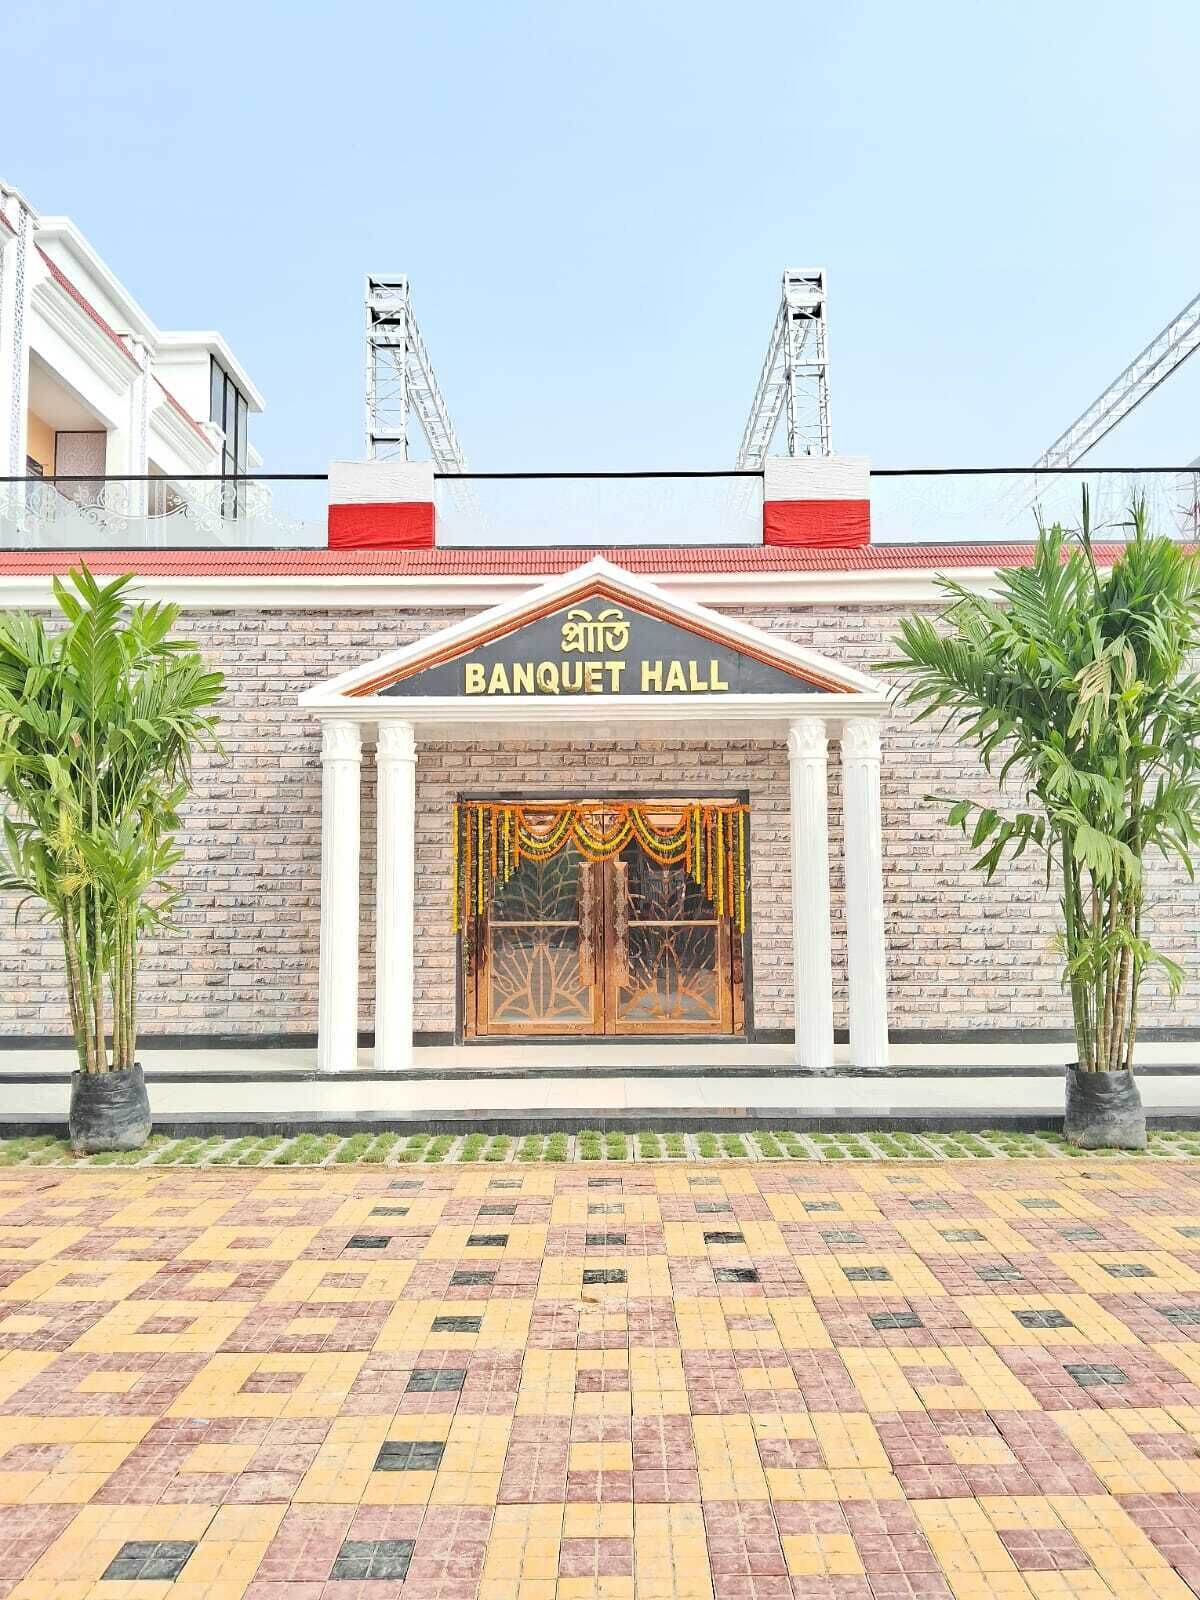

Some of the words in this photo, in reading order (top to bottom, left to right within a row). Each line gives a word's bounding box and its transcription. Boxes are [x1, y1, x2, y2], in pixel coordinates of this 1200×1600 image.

[561, 609, 631, 653] প্রীতি
[464, 661, 626, 694] BANQUET
[641, 659, 729, 692] HALL
